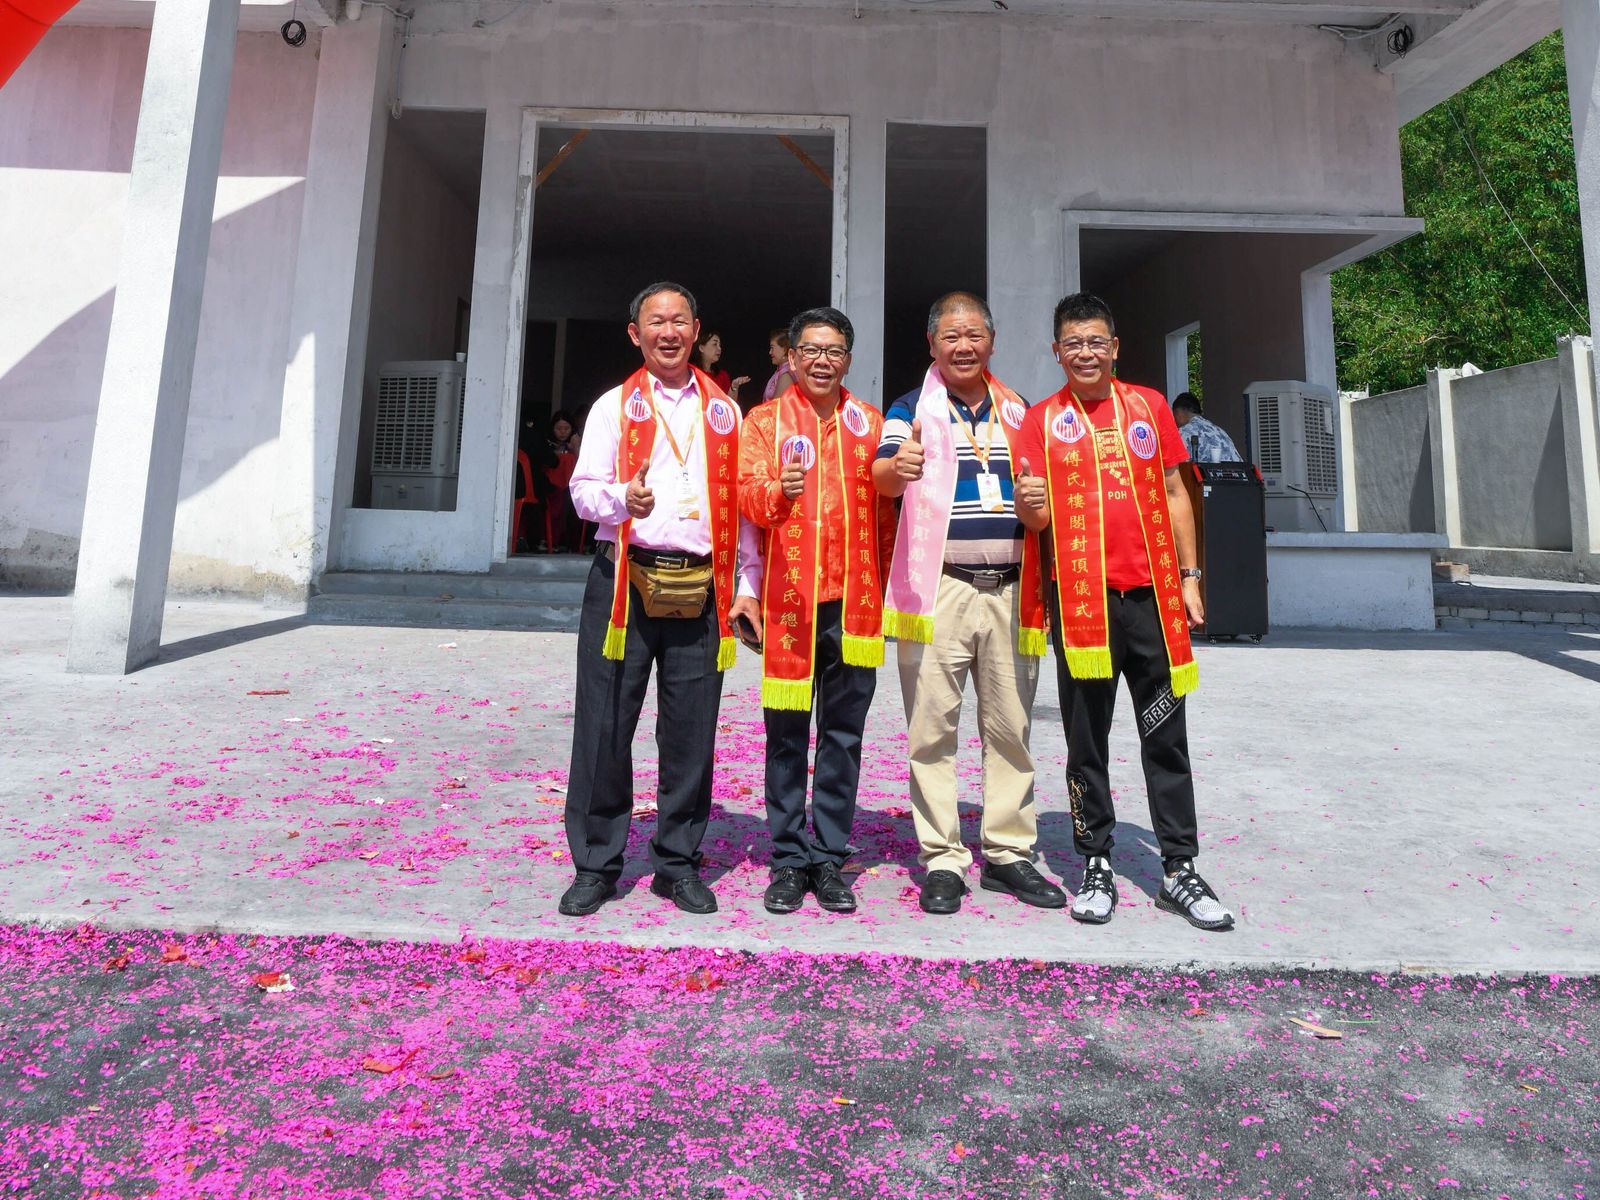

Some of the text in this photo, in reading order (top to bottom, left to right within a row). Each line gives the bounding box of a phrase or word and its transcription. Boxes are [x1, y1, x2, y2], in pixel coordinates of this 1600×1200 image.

[1062, 449, 1093, 619] 傅氏樓閣封頂儀式
[1107, 490, 1128, 500] POH
[1144, 466, 1184, 634] 馬來西亞傅氏總會
